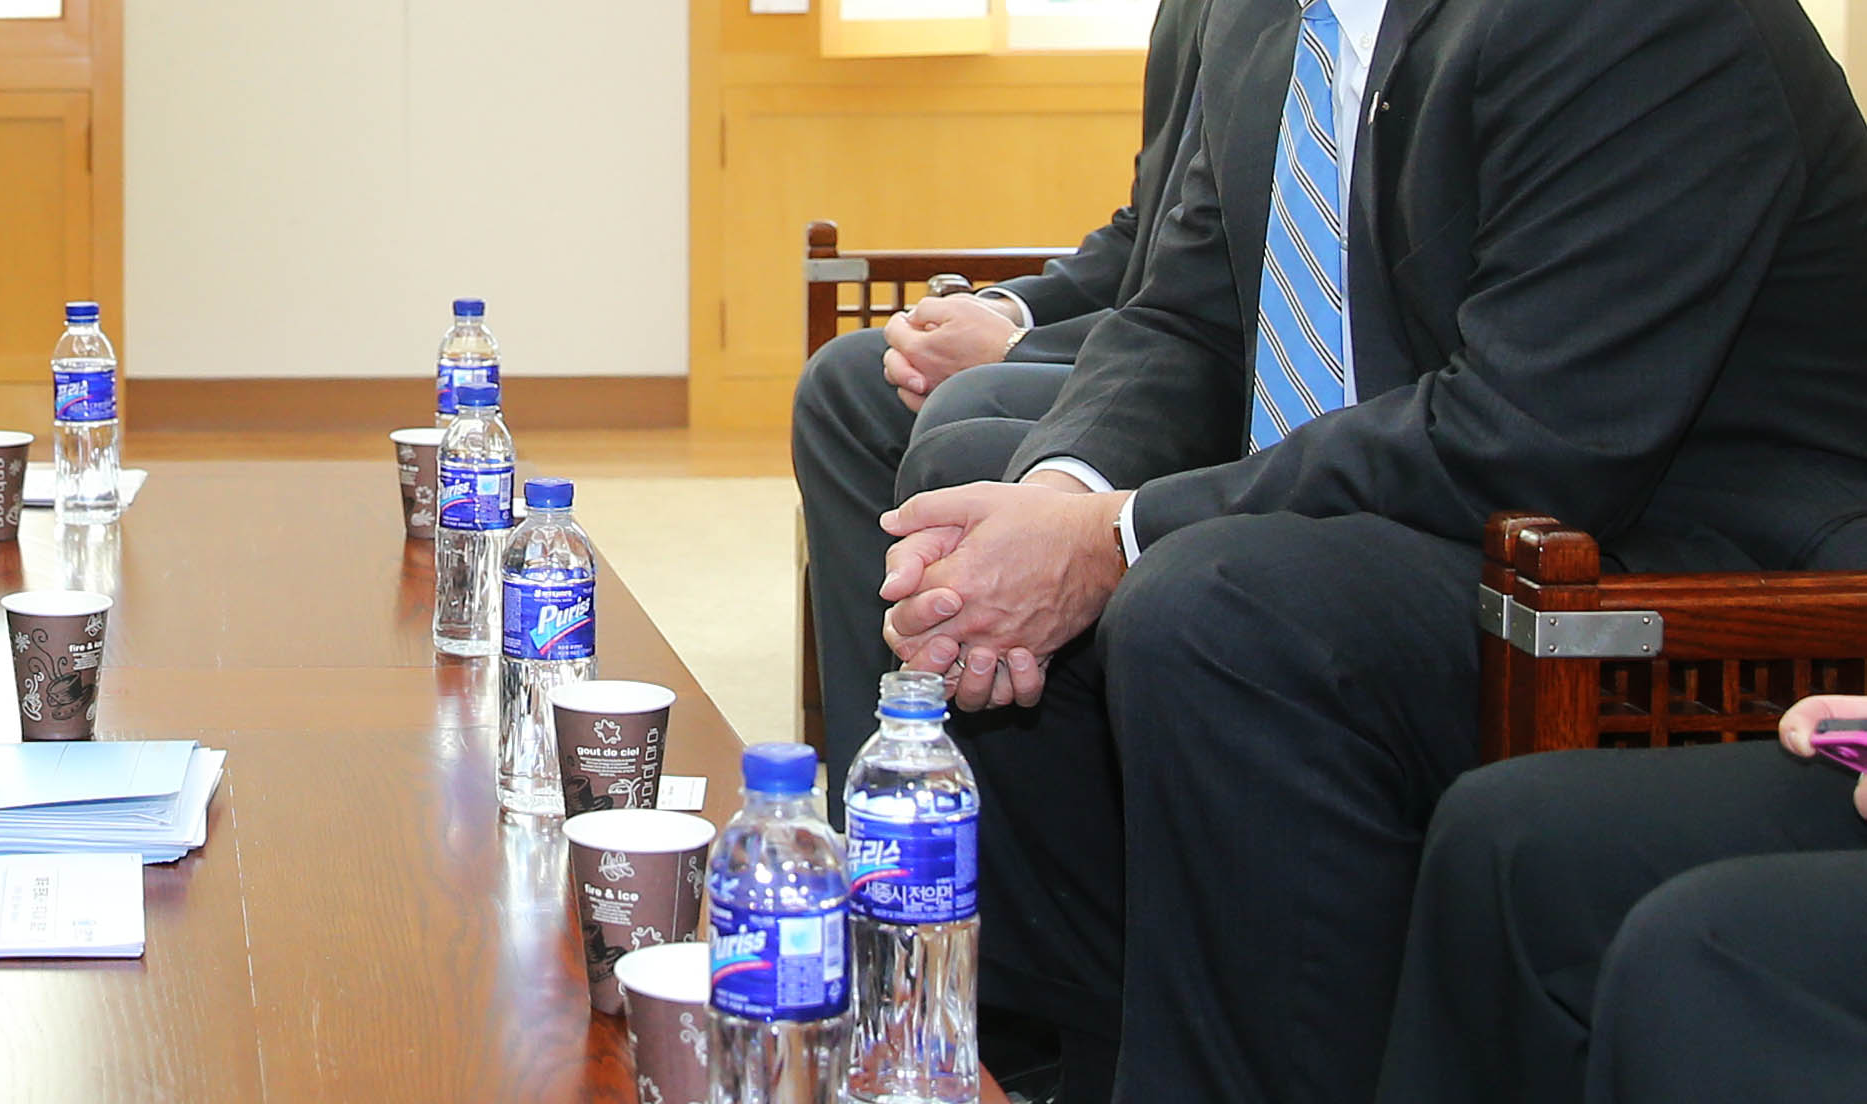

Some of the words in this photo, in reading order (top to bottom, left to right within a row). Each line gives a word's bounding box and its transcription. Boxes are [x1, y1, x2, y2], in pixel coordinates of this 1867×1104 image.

[577, 746, 601, 756] gout
[620, 746, 640, 757] ciel
[848, 839, 901, 873] 퓨리스
[584, 883, 602, 897] fire
[605, 888, 615, 899] &
[617, 889, 640, 902] ice
